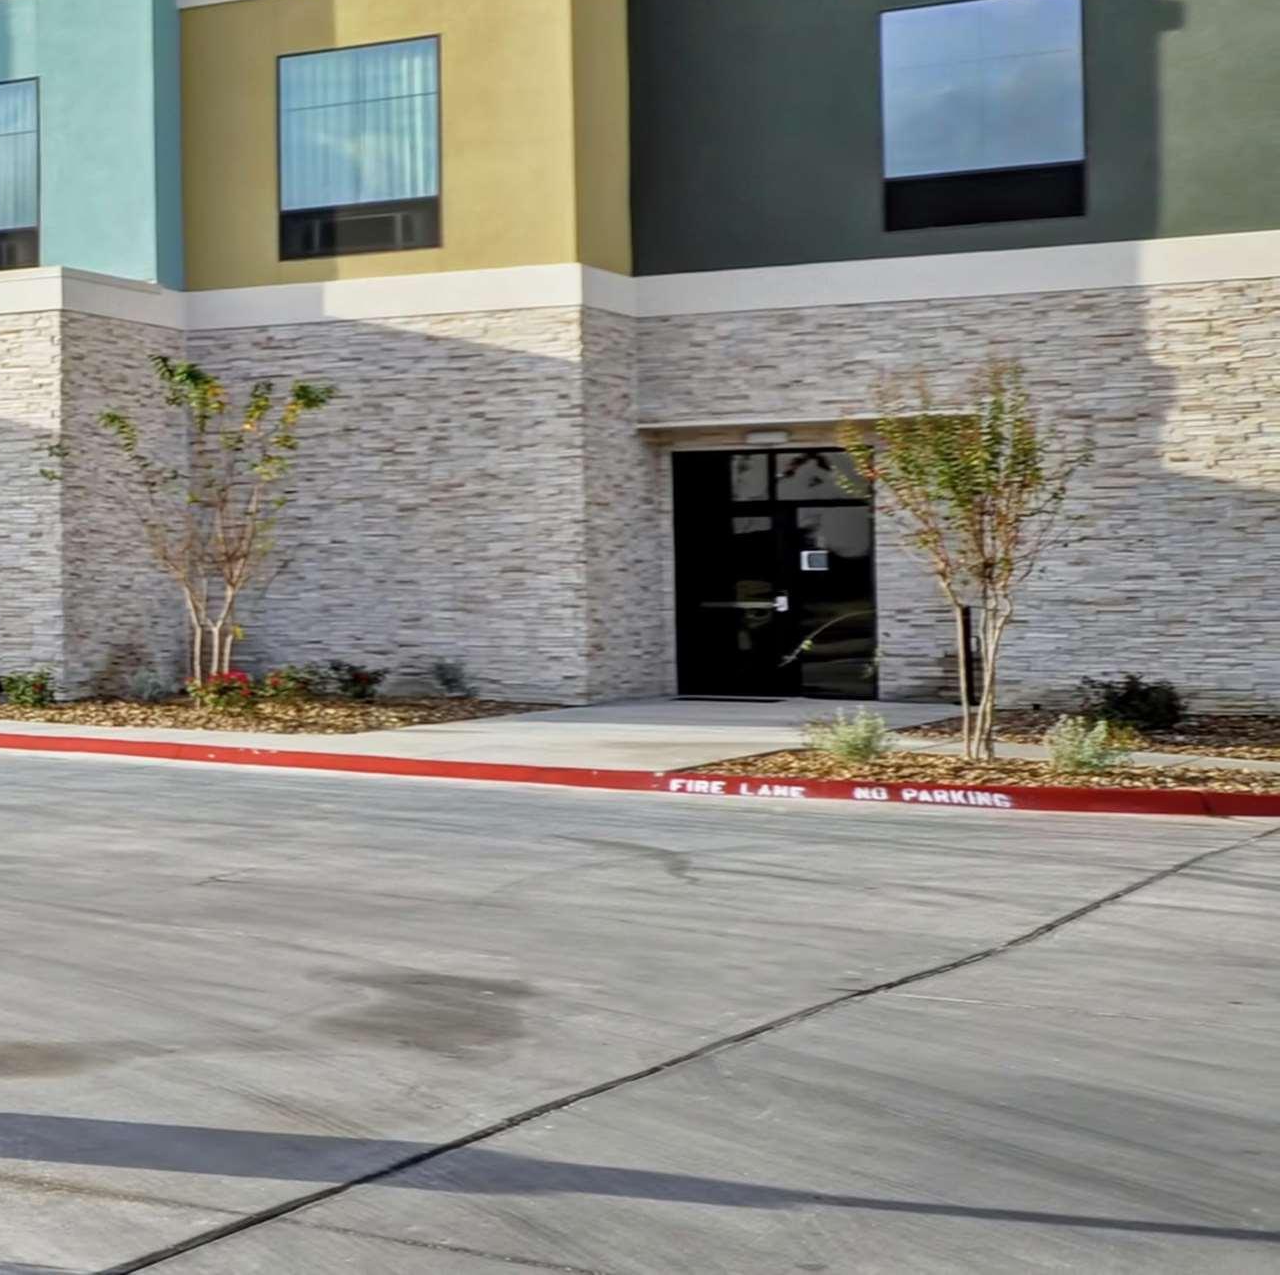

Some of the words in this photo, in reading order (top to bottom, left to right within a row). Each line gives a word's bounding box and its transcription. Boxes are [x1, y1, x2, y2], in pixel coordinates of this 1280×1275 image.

[669, 778, 726, 795] FIRE
[740, 782, 807, 798] LANE
[853, 786, 888, 801] NO
[902, 787, 1012, 809] PARKING
